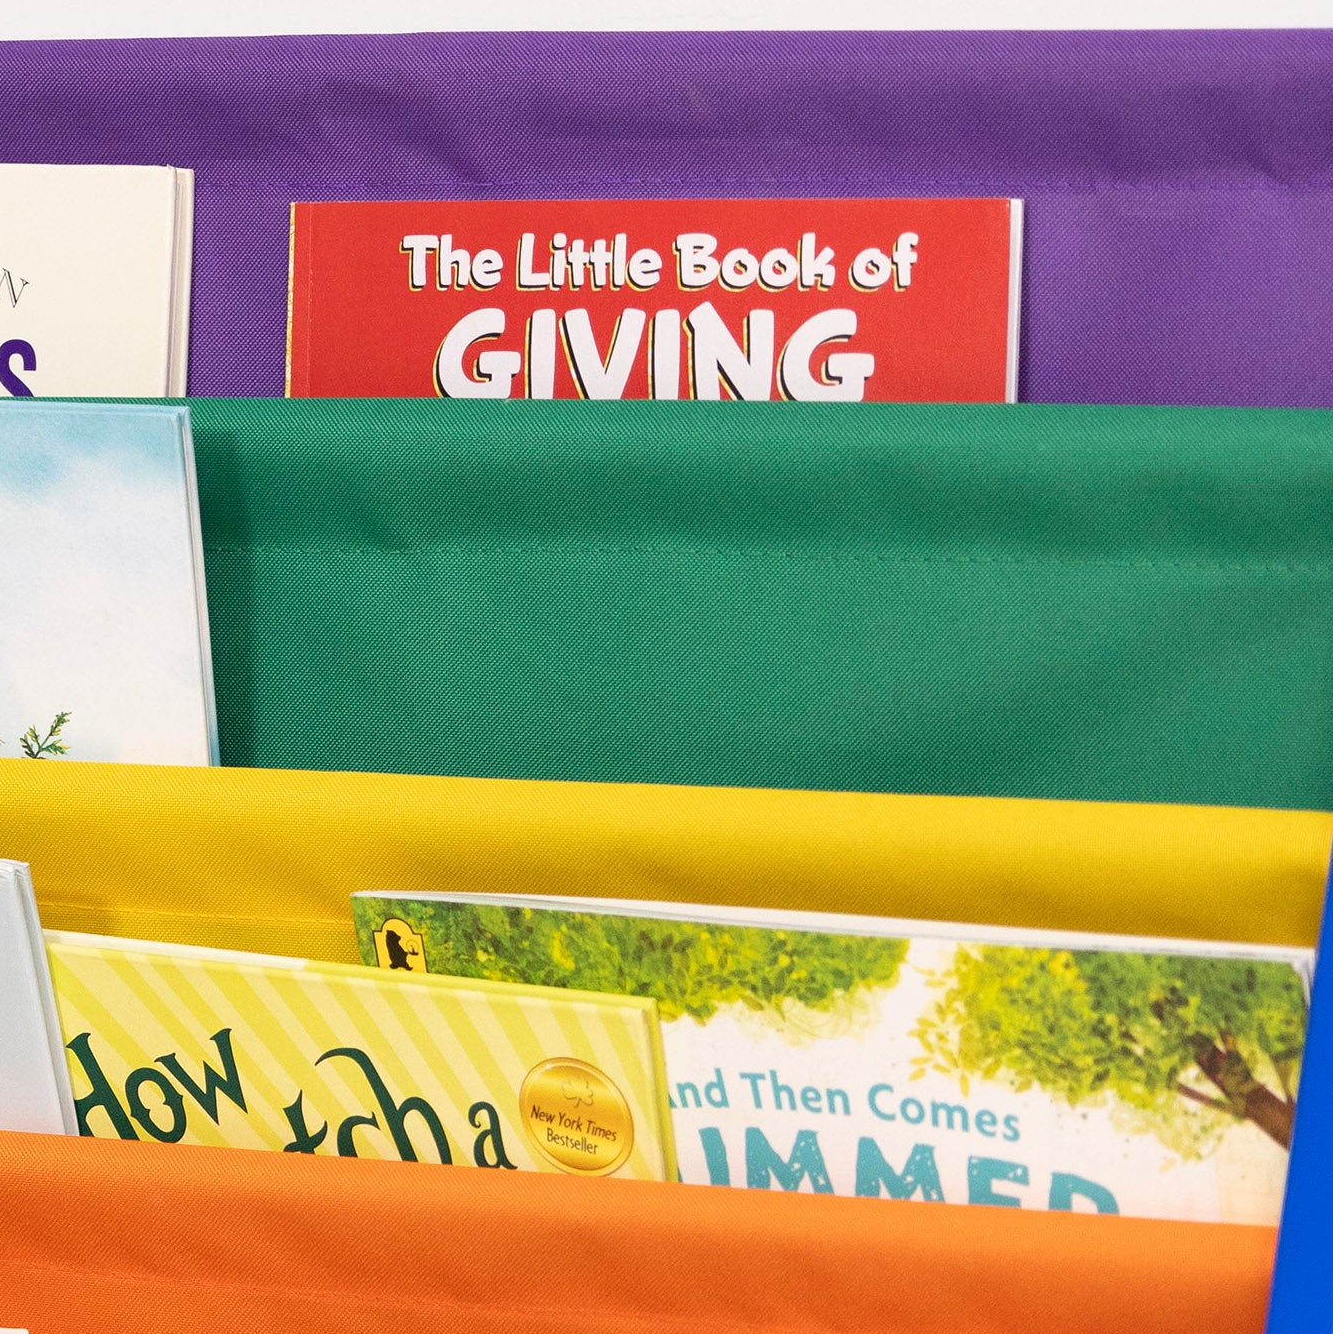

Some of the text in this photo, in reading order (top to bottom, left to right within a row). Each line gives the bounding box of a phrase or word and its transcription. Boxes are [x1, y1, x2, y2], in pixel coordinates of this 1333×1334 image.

[399, 232, 919, 292] The Little Book of
[434, 301, 875, 403] GIVING
[66, 1028, 247, 1143] How
[668, 1067, 1021, 1143] nd Then Comes
[530, 1105, 617, 1142] New York Times
[546, 1127, 598, 1154] Bestseller
